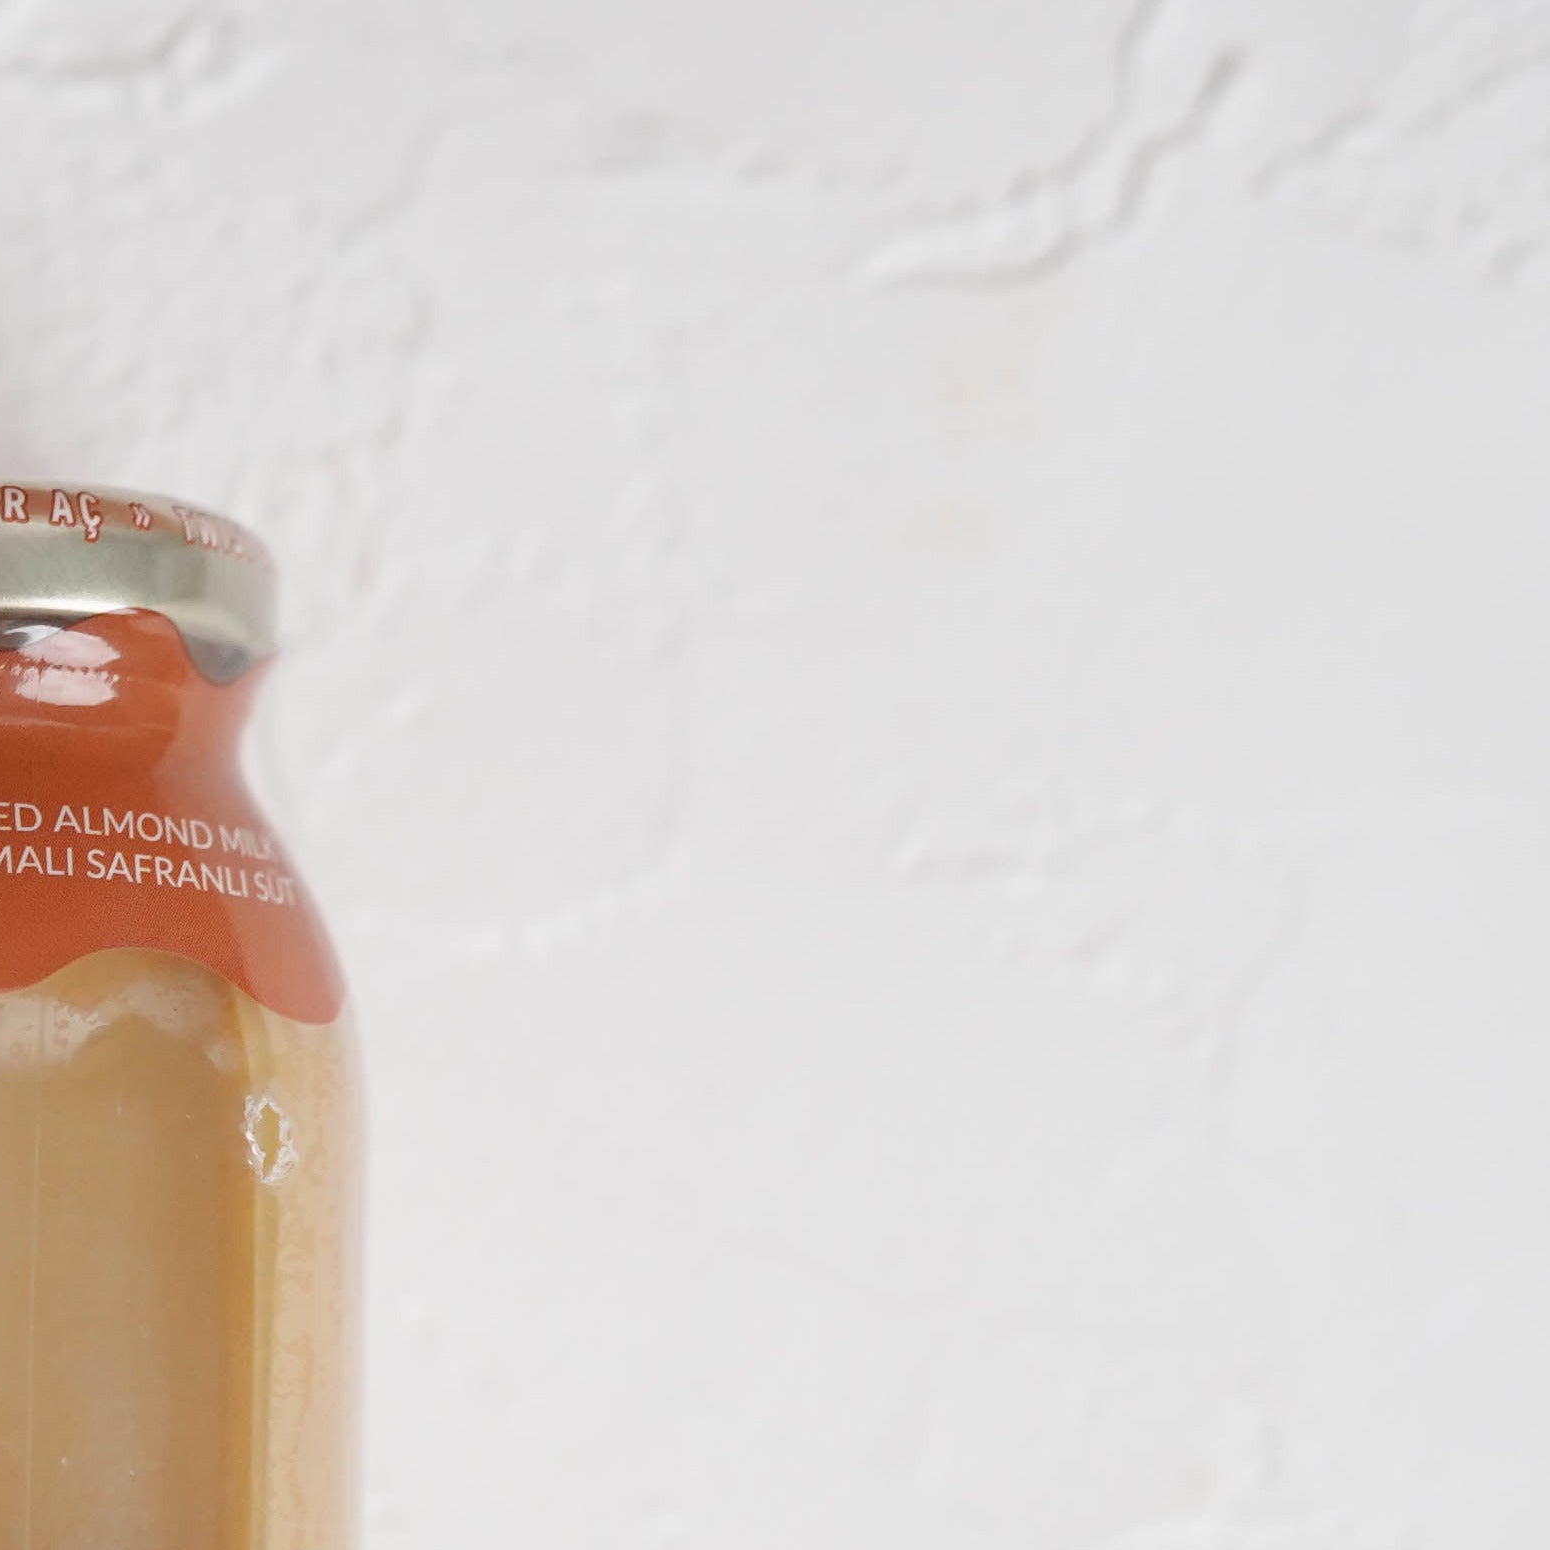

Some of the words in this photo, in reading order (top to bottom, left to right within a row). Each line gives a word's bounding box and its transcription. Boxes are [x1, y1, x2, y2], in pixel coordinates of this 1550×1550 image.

[49, 488, 102, 543] AÇ
[54, 806, 213, 850] ALMOND
[86, 850, 249, 898] SAFRANLI
